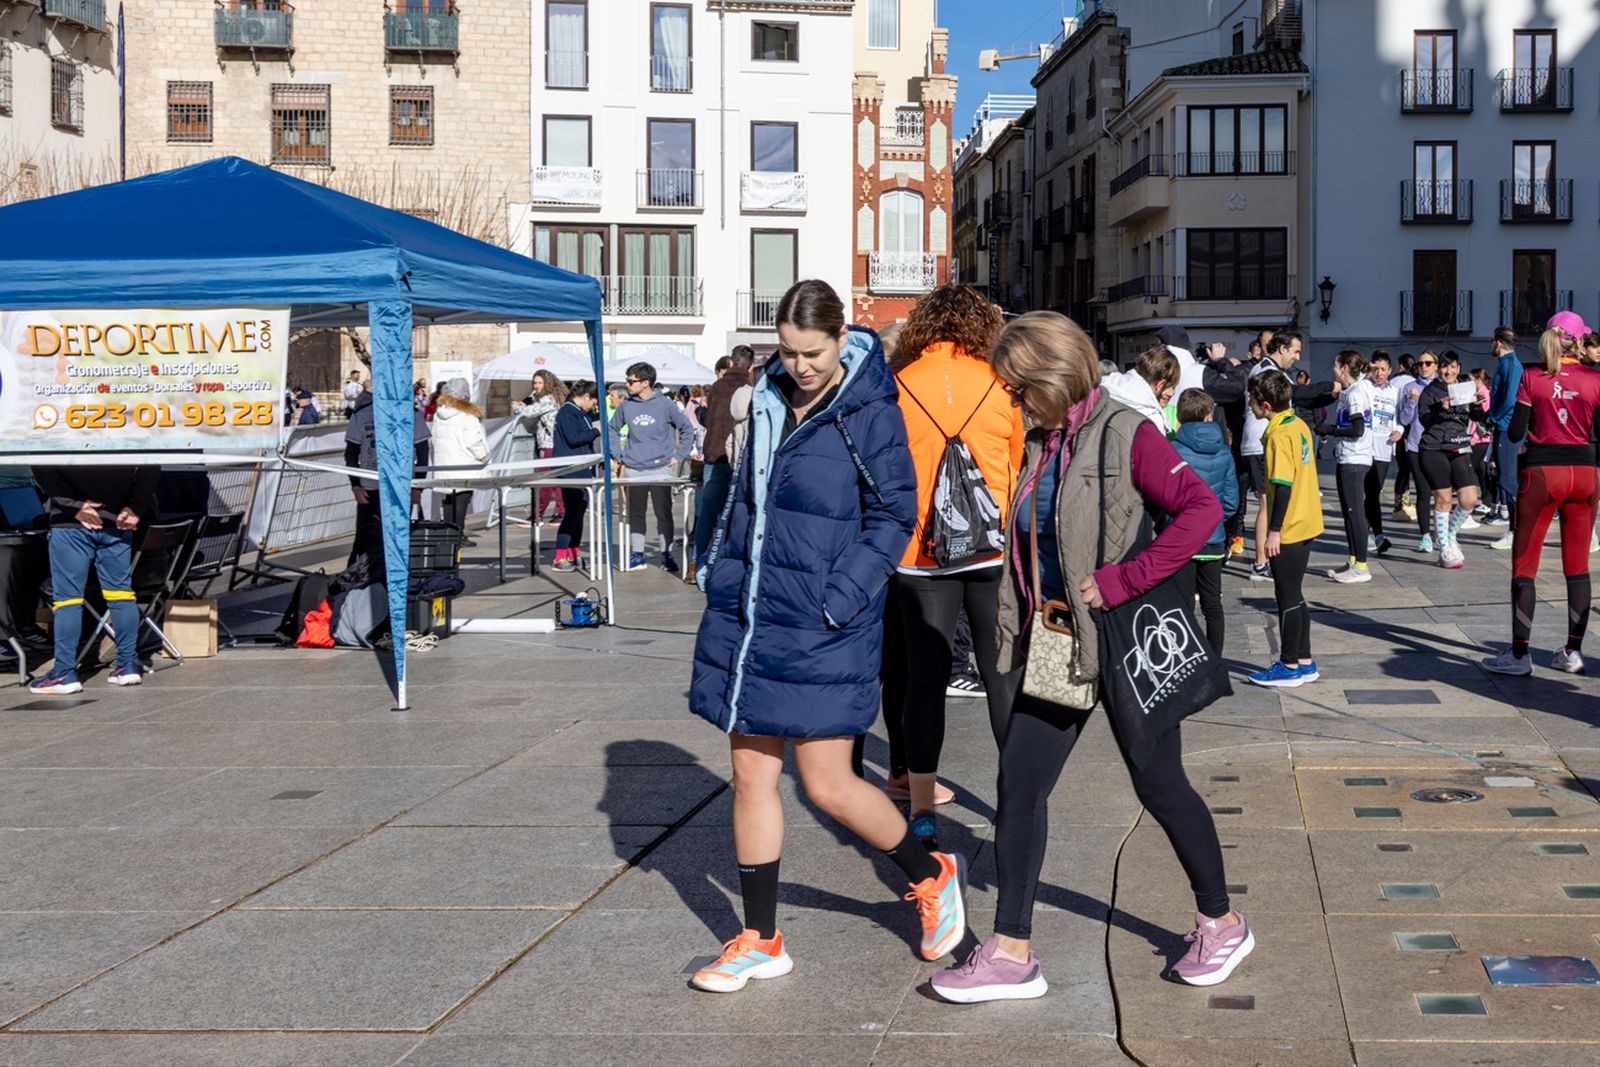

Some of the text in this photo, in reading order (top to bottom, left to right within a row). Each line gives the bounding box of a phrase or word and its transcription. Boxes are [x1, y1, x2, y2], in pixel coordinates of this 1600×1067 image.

[27, 320, 257, 357] DEPORTIME
[66, 362, 239, 377] Cronometraje e Inscripciones
[34, 381, 272, 396] Organización de eventos Dorsales y ropa deportiva
[65, 401, 274, 429] 623 01 98 28
[707, 546, 719, 565] POLO
